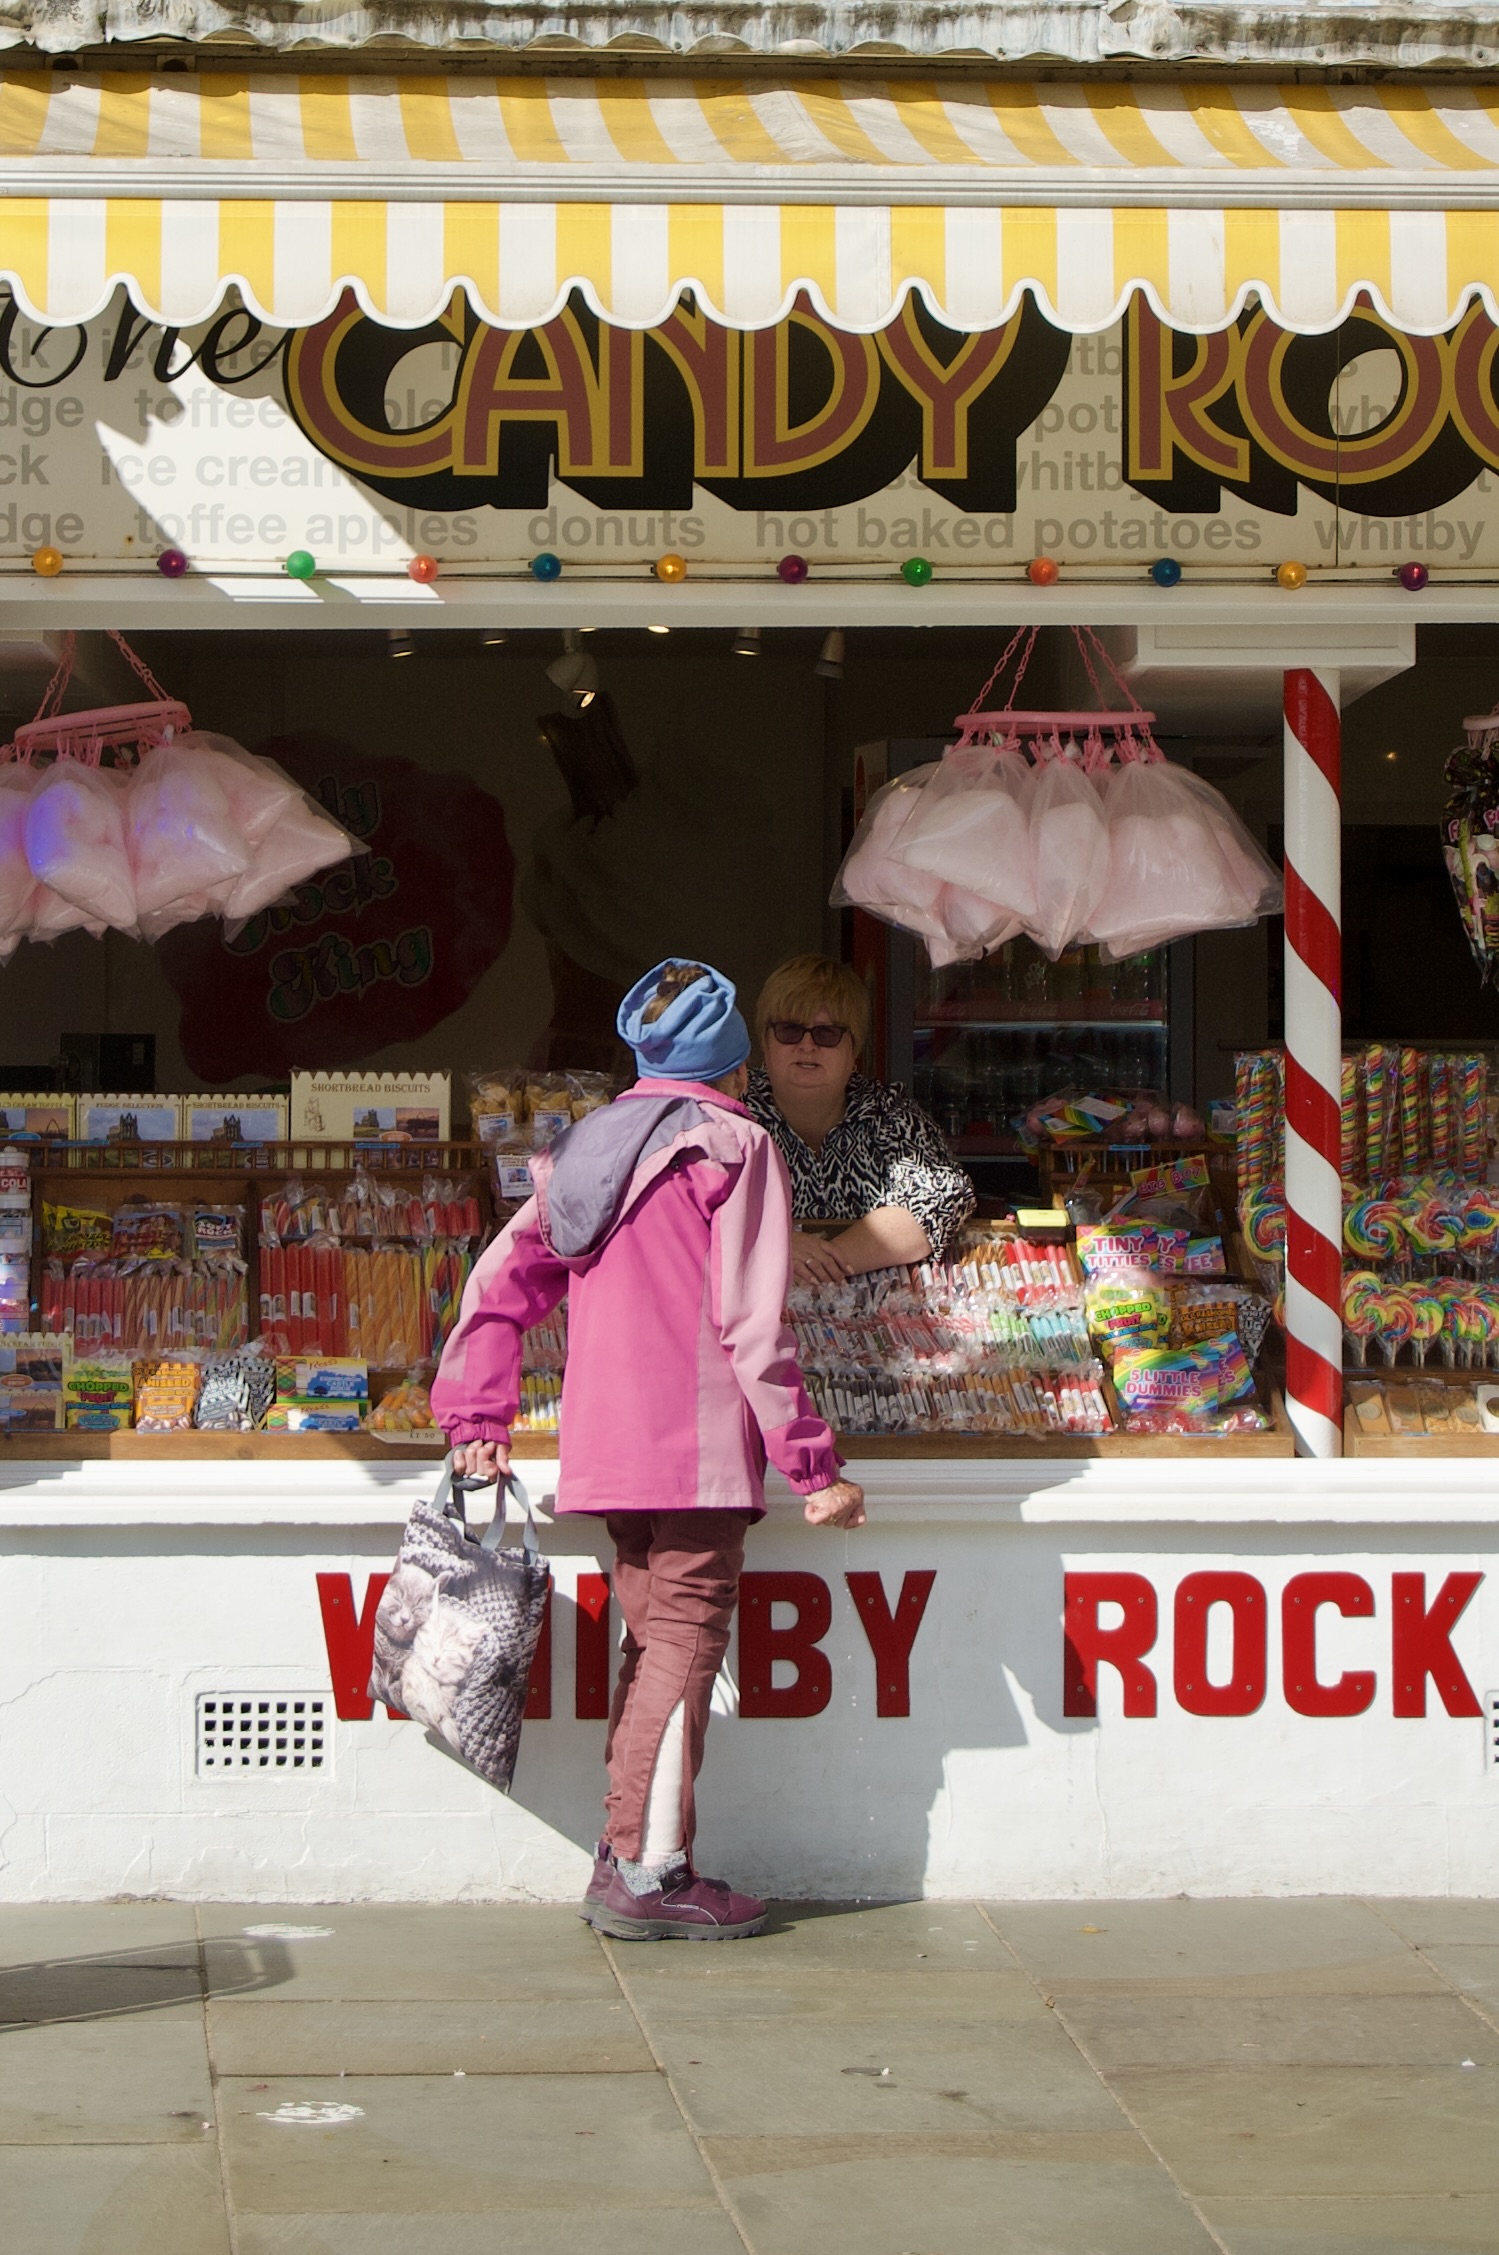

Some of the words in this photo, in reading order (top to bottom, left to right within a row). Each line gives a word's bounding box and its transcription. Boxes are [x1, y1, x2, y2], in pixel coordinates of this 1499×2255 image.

[285, 284, 1023, 483] CANDY
[134, 388, 286, 429] toffee
[102, 445, 177, 486] ice
[134, 503, 287, 545] toffee
[305, 506, 479, 555] apples
[528, 506, 706, 548] donuts
[756, 510, 838, 548] hot
[857, 510, 1014, 550] baked
[1034, 513, 1262, 558] potatoes
[1314, 515, 1485, 560] whitby
[311, 1083, 382, 1093] SHORTBREAD
[384, 1083, 431, 1093] BISCUITS
[1092, 1236, 1145, 1253] TINY
[1086, 1254, 1150, 1269] TITTIES
[1095, 1302, 1153, 1323] CHOPPED
[1108, 1314, 1142, 1330] FRUIT
[1130, 1369, 1140, 1382] 5
[1143, 1369, 1200, 1384] LITTLE
[68, 1381, 129, 1392] CHOPPED
[1125, 1381, 1203, 1397] DUMMIES
[1063, 1570, 1486, 1718] ROCK
